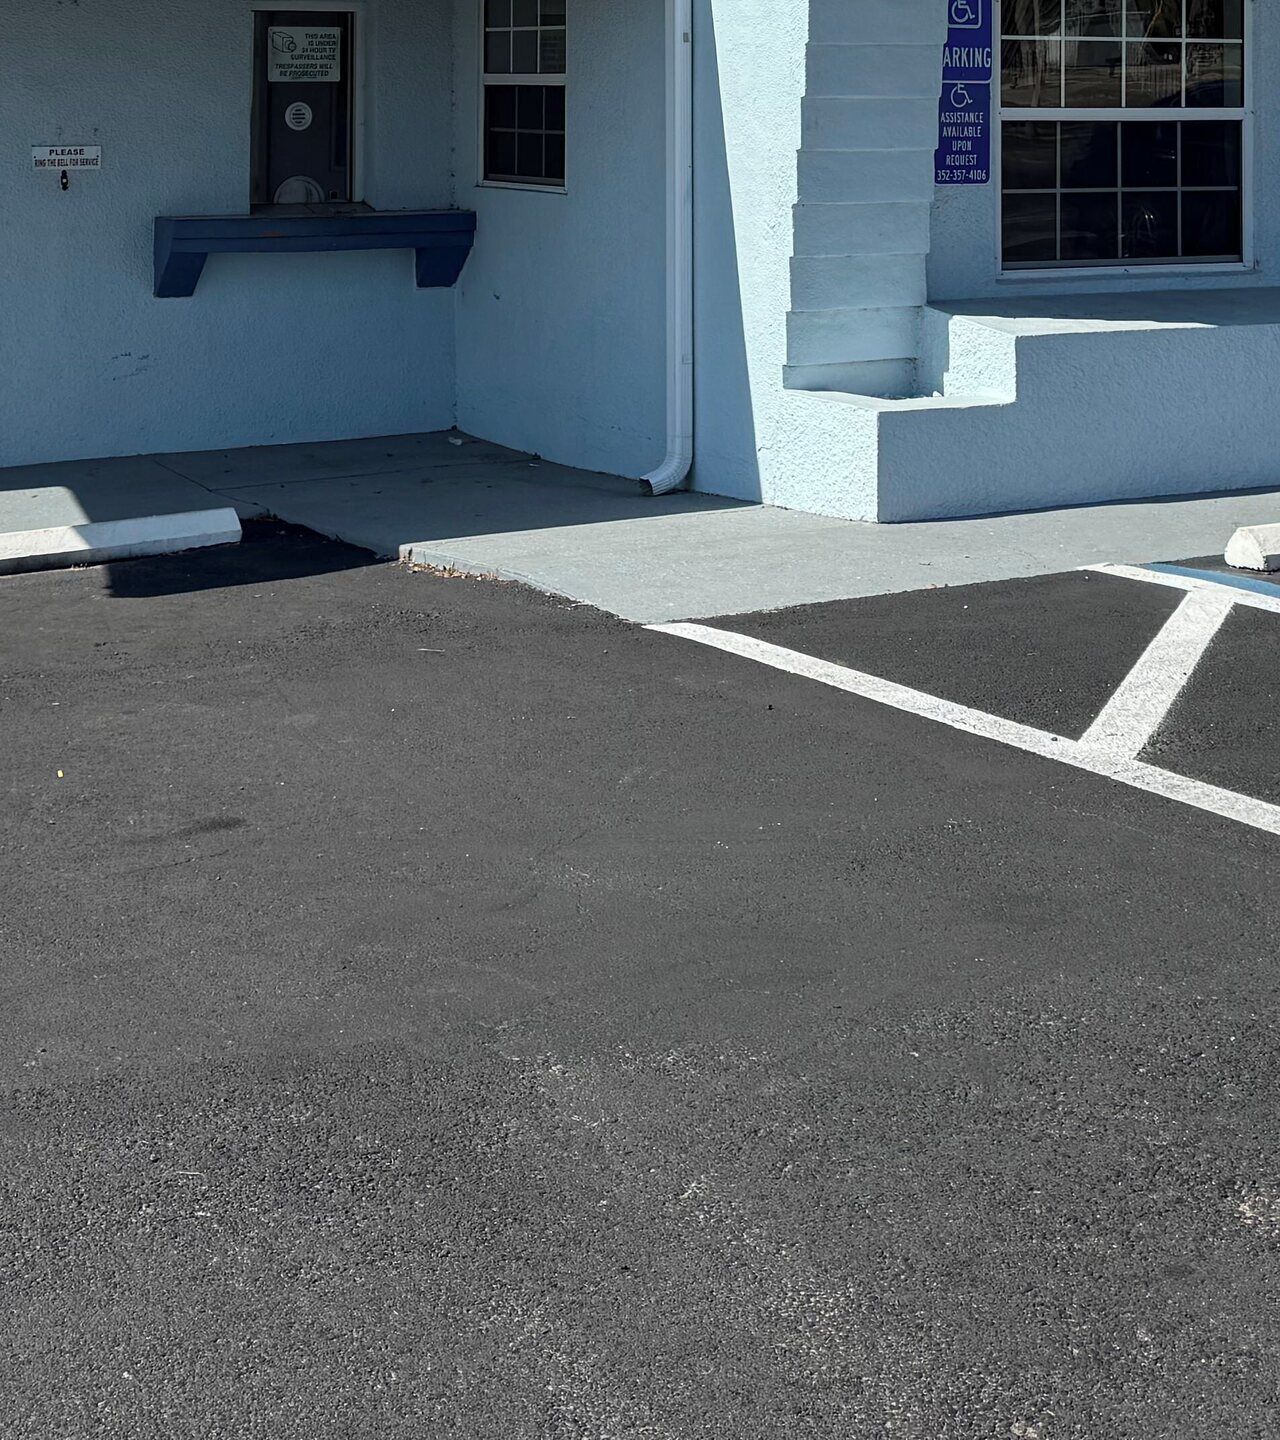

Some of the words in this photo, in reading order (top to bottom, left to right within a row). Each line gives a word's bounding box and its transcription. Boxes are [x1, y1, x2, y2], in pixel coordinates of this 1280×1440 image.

[942, 47, 991, 67] ARKING
[940, 112, 984, 123] ASSISTANCE
[942, 126, 982, 137] AVAILABLE
[952, 140, 972, 151] UPON
[49, 148, 85, 156] PLEASE
[945, 154, 977, 166] REQUEST
[937, 169, 987, 181] 352-357-4106
